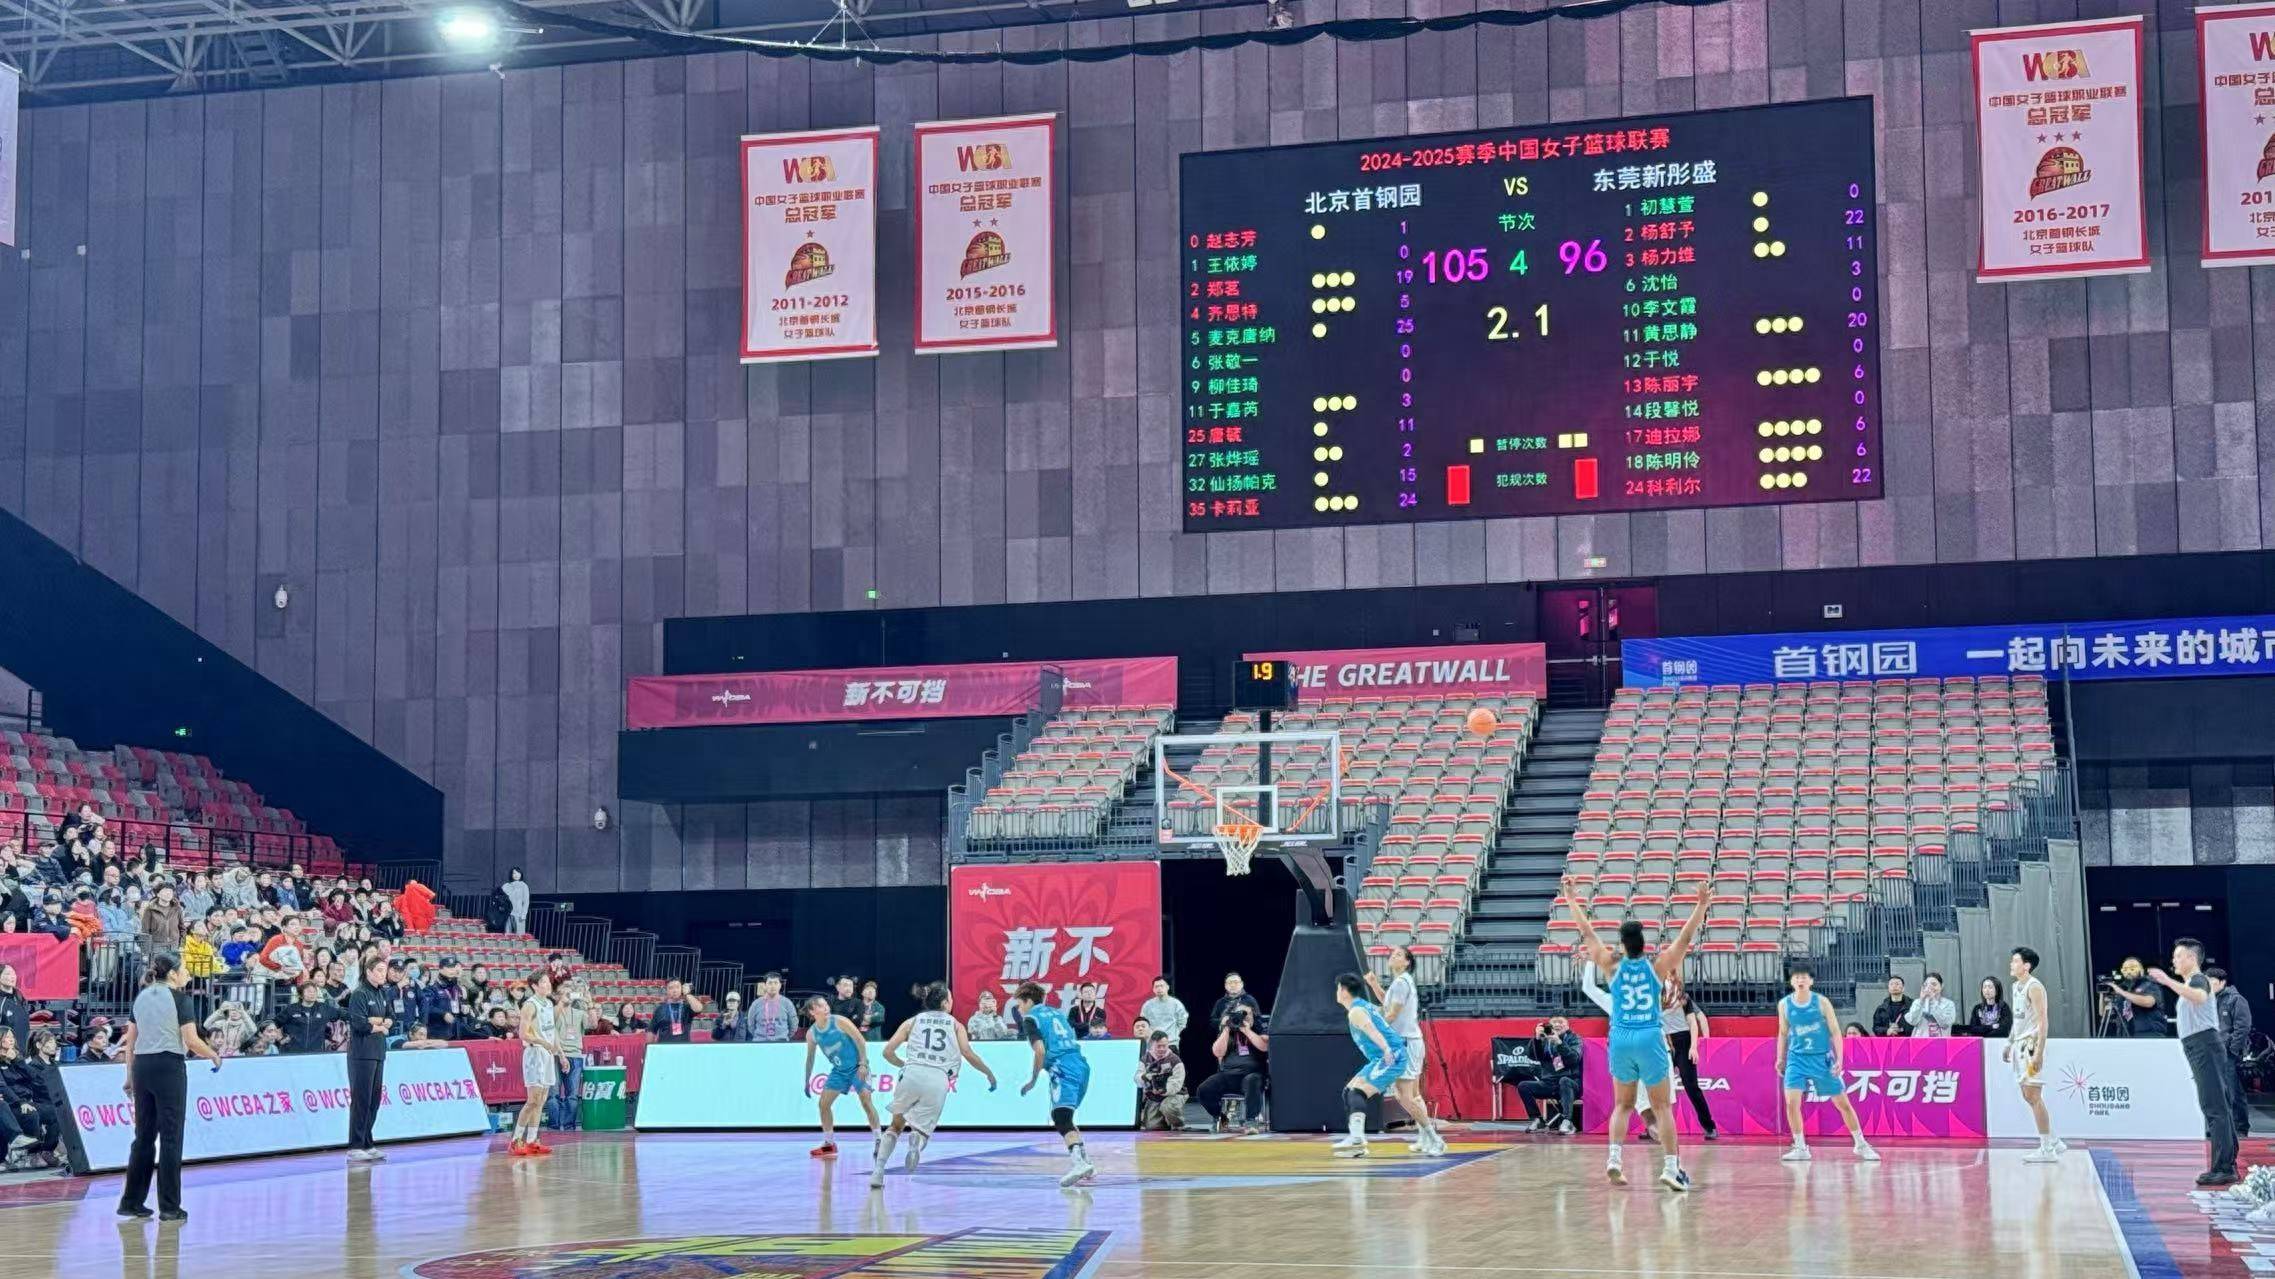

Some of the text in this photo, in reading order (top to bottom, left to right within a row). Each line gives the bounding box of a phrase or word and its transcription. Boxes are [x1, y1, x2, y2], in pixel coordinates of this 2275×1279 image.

[2214, 71, 2275, 88] 中国女子
[2027, 103, 2092, 125] 总冠军
[1360, 127, 1670, 172] 2024-2025赛季中国女子篮球联赛
[1304, 159, 1717, 215] 北京首钢园 VS 东莞新彤盛
[1624, 203, 1632, 217] 1
[1849, 183, 1859, 199] 0
[785, 204, 837, 224] 总冠军
[959, 192, 1013, 213] 总冠军
[2013, 203, 2111, 224] 2016-2017
[1190, 234, 1199, 249] 0
[1400, 220, 1407, 234] 1
[1498, 213, 1536, 233] 节次
[1624, 209, 1864, 242] 2 杨舒予 22
[1191, 259, 1198, 272] 1
[1399, 244, 1409, 260] 0
[1422, 239, 1608, 284] 105 4 96
[1625, 235, 1862, 268] 3 杨力维 11
[1190, 282, 1199, 297] 2
[1396, 269, 1414, 284] 19
[1626, 260, 1861, 293] 6 沈怡 3
[771, 294, 849, 311] 2011-2012
[946, 284, 1026, 301] 2015-2016
[1622, 302, 1641, 318] 10
[1852, 286, 1862, 302] 0
[1190, 307, 1200, 320] 4
[1191, 330, 1200, 346] 5
[1623, 312, 1868, 343] 11 黄思静 20
[1191, 356, 1201, 370] 6
[1401, 343, 1411, 358] 0
[1624, 338, 1864, 369] 12 于悦 0
[1191, 380, 1201, 394] 9
[1401, 367, 1412, 383] 0
[1624, 378, 1642, 393] 13
[1854, 364, 1864, 379] 6
[1189, 405, 1204, 419] 11
[1401, 392, 1412, 408] 3
[1625, 403, 1643, 419] 14
[1854, 390, 1865, 405] 0
[1188, 428, 1206, 444] 25
[1398, 417, 1414, 432] 11
[1496, 436, 1548, 451] 暂停次数
[1625, 429, 1643, 444] 17
[1856, 416, 1866, 431] 6
[1188, 453, 1206, 468] 27
[1402, 442, 1412, 457] 2
[1626, 454, 1644, 470] 18
[1856, 442, 1867, 457] 6
[1188, 477, 1206, 493] 32
[1399, 467, 1417, 483] 15
[1496, 472, 1548, 487] 犯规次数
[1626, 467, 1872, 497] 24 科利尔 22
[1189, 501, 1206, 517] 35
[1400, 491, 1418, 507] 24
[1253, 662, 1273, 680] 1.9
[1337, 659, 1512, 687] GREATWALL
[1773, 641, 1918, 678] 首钢园
[842, 679, 947, 707] 新不可挡
[1000, 926, 1114, 980] 新不
[1620, 984, 1653, 1010] 35
[922, 1027, 947, 1052] 13
[1053, 1017, 1068, 1038] 4
[1804, 1038, 1814, 1050] 2
[197, 1090, 295, 1121] @WCBA之家
[398, 1079, 478, 1105] @WCBA之家
